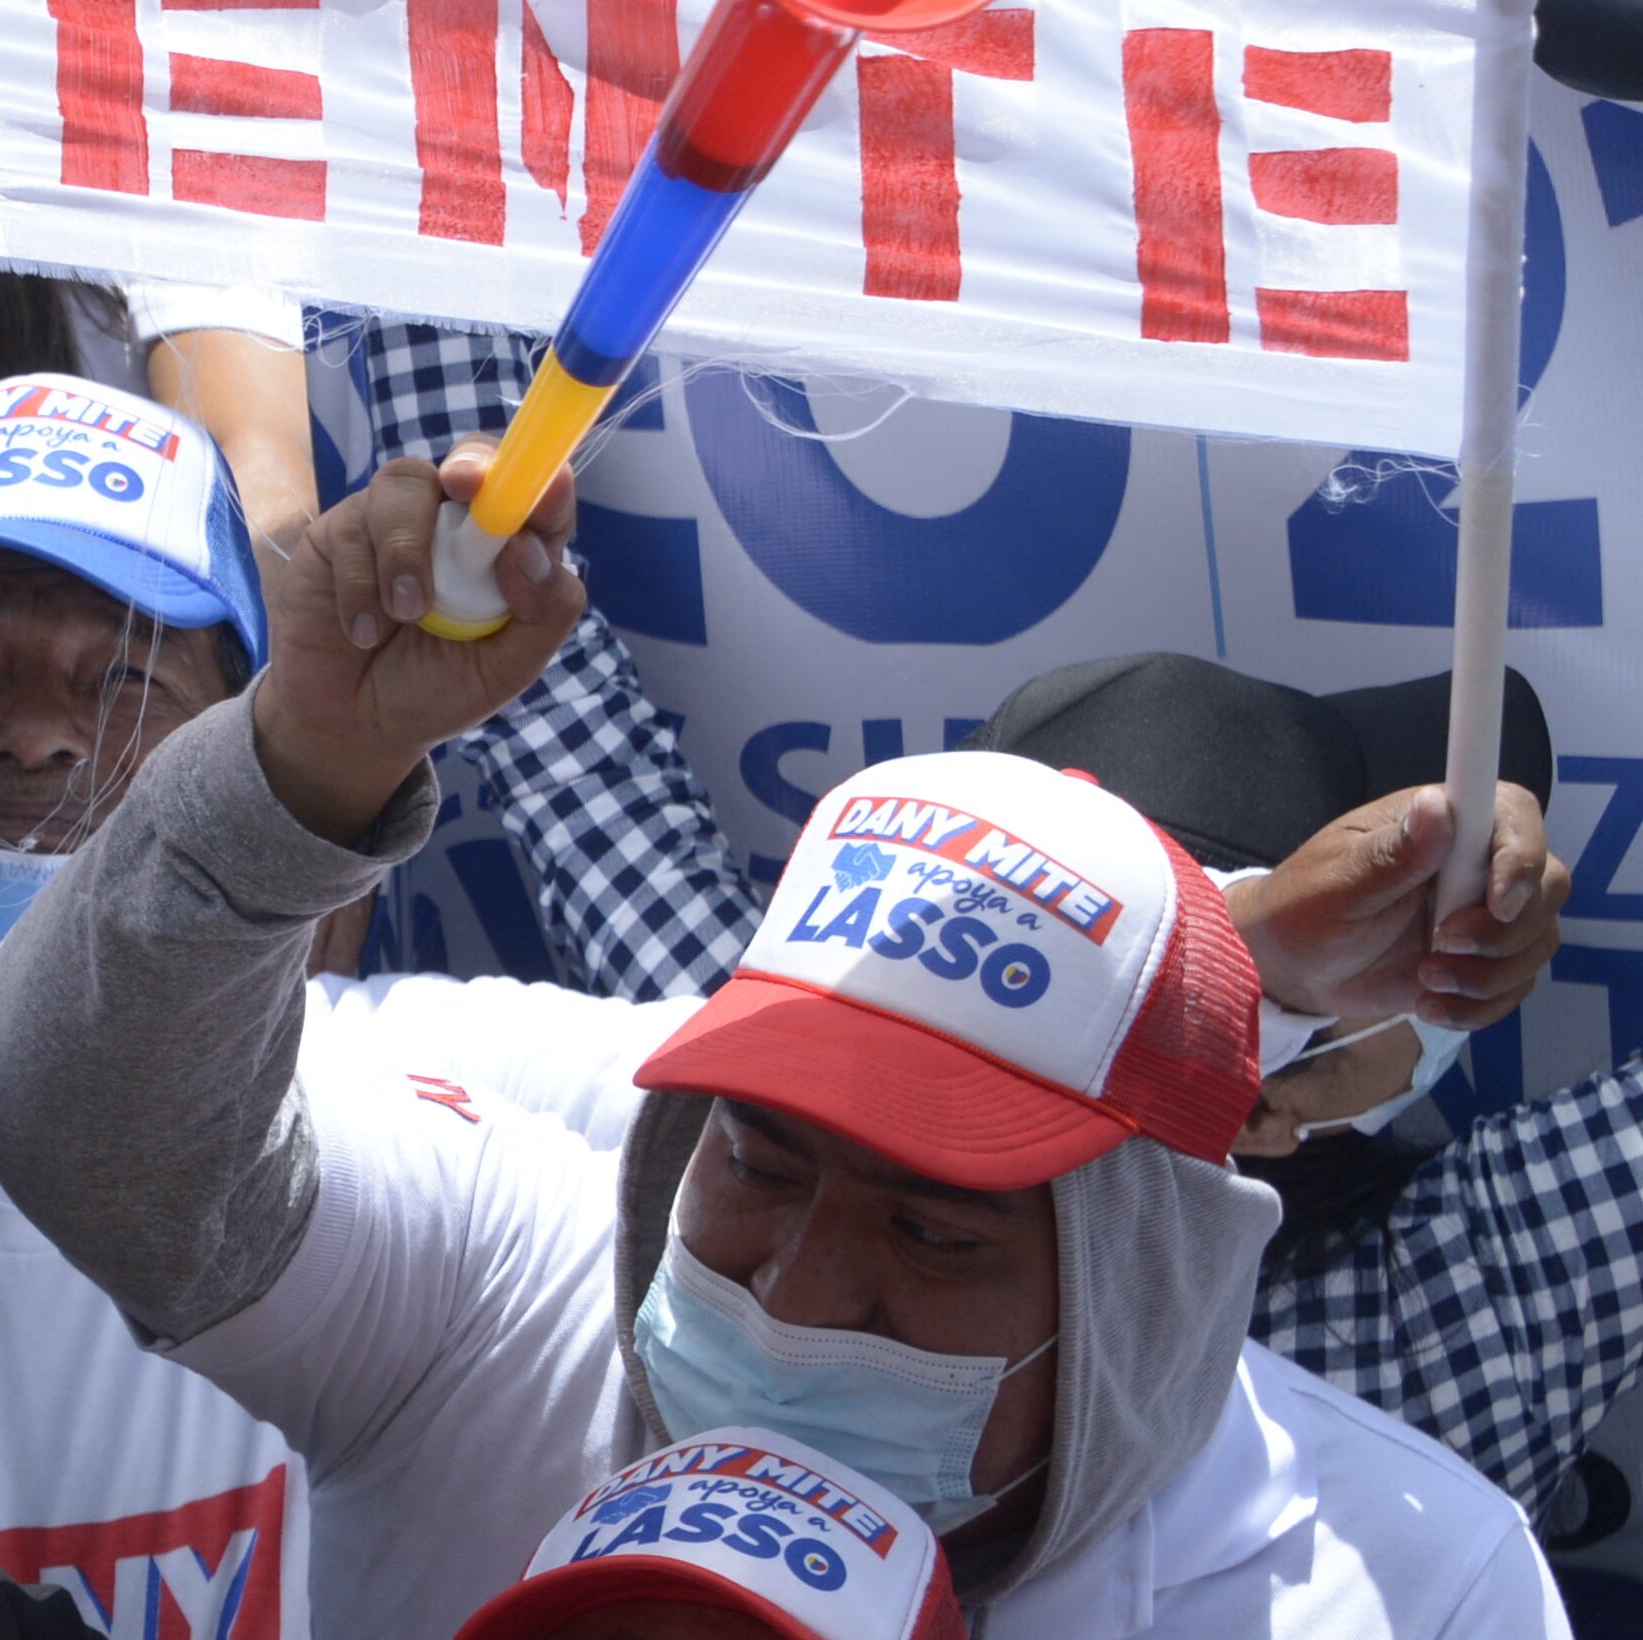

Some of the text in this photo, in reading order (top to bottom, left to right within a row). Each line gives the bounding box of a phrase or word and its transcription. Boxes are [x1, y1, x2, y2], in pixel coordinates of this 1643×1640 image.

[37, 389, 173, 450] MITE
[102, 439, 121, 452] a
[833, 798, 977, 850] DANY
[963, 828, 1113, 932] MITE
[906, 861, 1043, 931] apoya a
[785, 885, 1052, 1009] LASSO
[581, 1445, 892, 1541] DANY MITE
[687, 1477, 832, 1532] apoya a
[568, 1501, 848, 1592] LASSO
